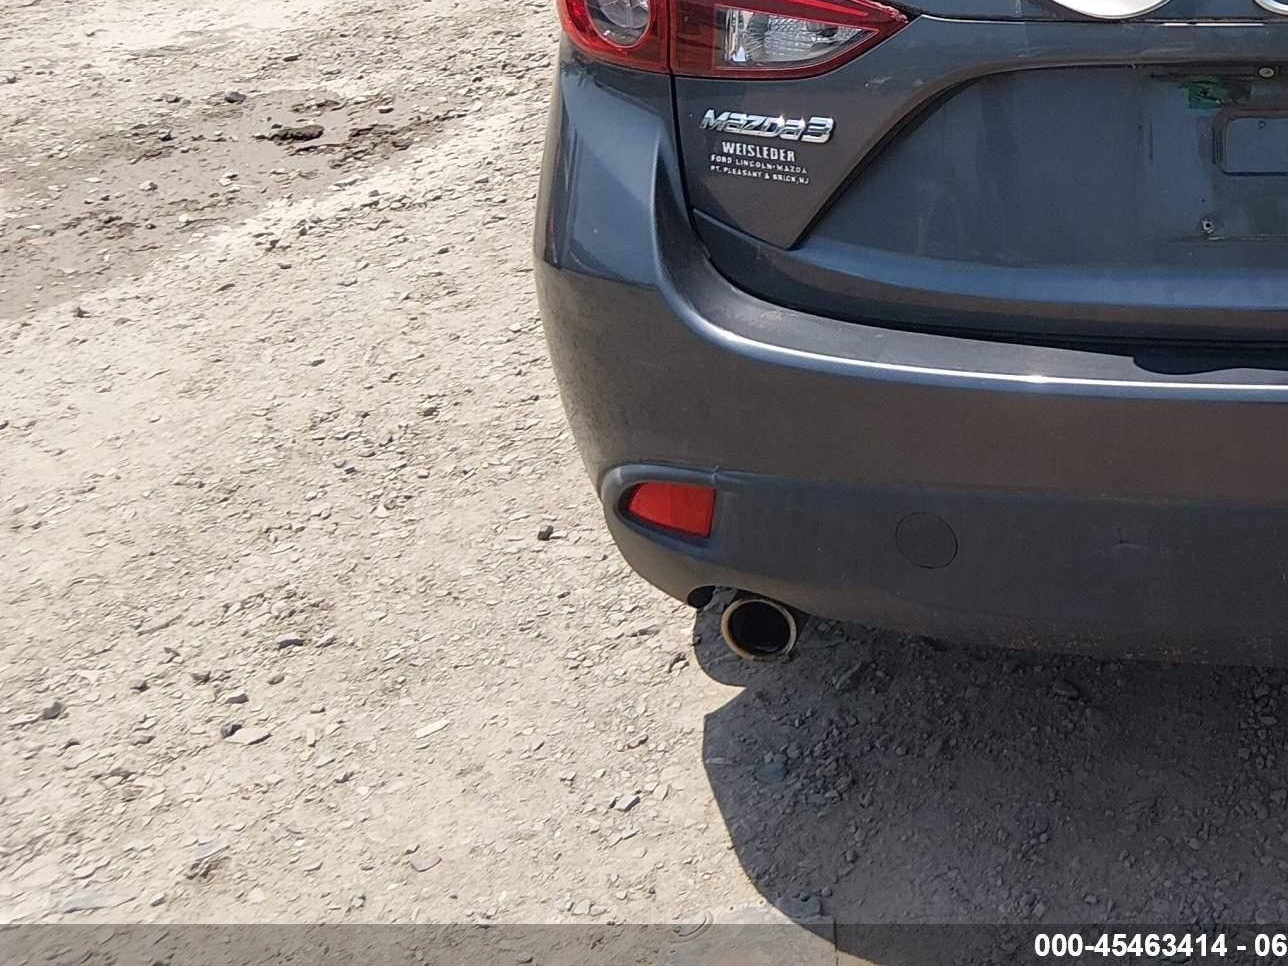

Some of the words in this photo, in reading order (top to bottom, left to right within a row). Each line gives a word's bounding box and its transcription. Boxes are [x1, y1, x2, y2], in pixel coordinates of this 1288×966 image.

[722, 141, 796, 161] WEISLEDER
[710, 154, 733, 164] FORD
[722, 167, 763, 178] PLEASANT
[764, 172, 771, 180] &
